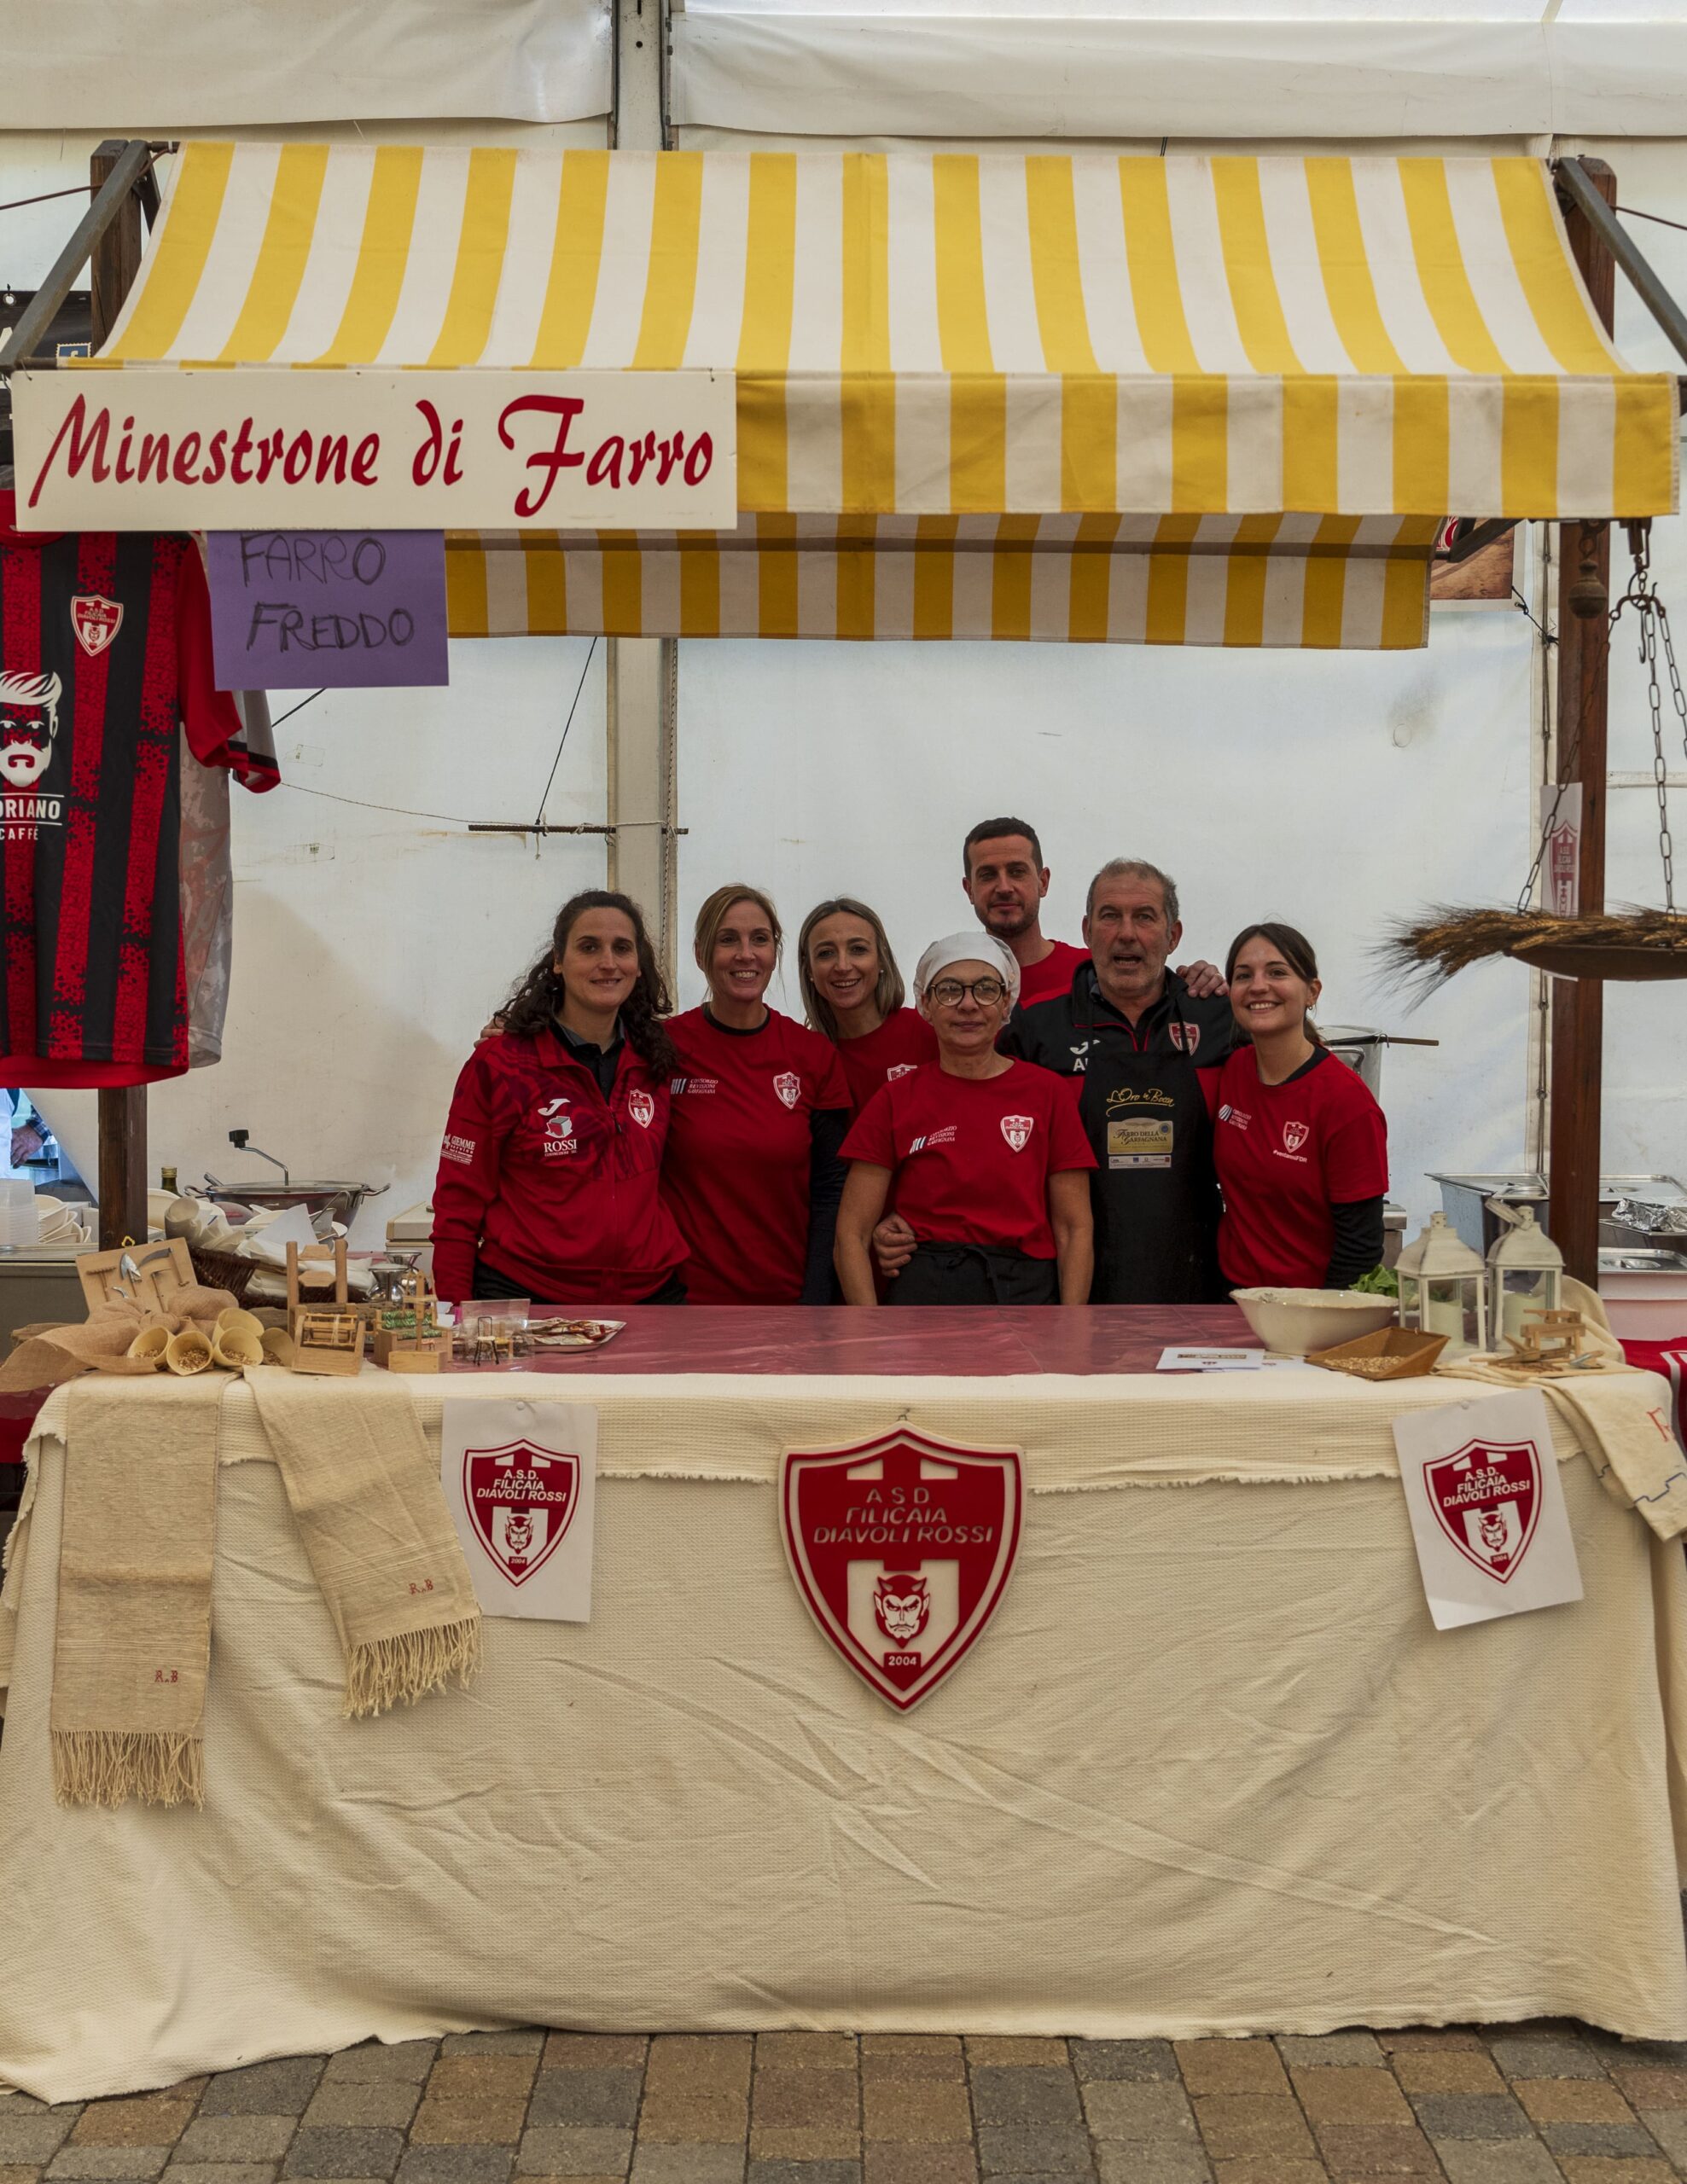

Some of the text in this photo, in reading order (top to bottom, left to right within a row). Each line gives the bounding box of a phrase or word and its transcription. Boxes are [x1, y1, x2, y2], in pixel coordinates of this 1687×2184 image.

[28, 394, 713, 518] Minestrone di Farro
[239, 531, 387, 588] FARRO
[246, 601, 416, 653] FREDDO
[1073, 1058, 1089, 1072] A
[451, 1136, 475, 1150] GIEMME
[544, 1139, 577, 1153] ROSSI
[503, 1469, 539, 1480] A.S.D.
[1464, 1466, 1499, 1482] A.S.D.
[493, 1478, 544, 1490] FILICAIA
[1457, 1475, 1507, 1494] FILICAIA
[476, 1488, 567, 1502] DIAVOLI ROSSI
[1443, 1479, 1530, 1507] DIAVOLI ROSSI
[813, 1526, 993, 1543] DIAVOLI ROSSI
[887, 1656, 917, 1666] 2004
